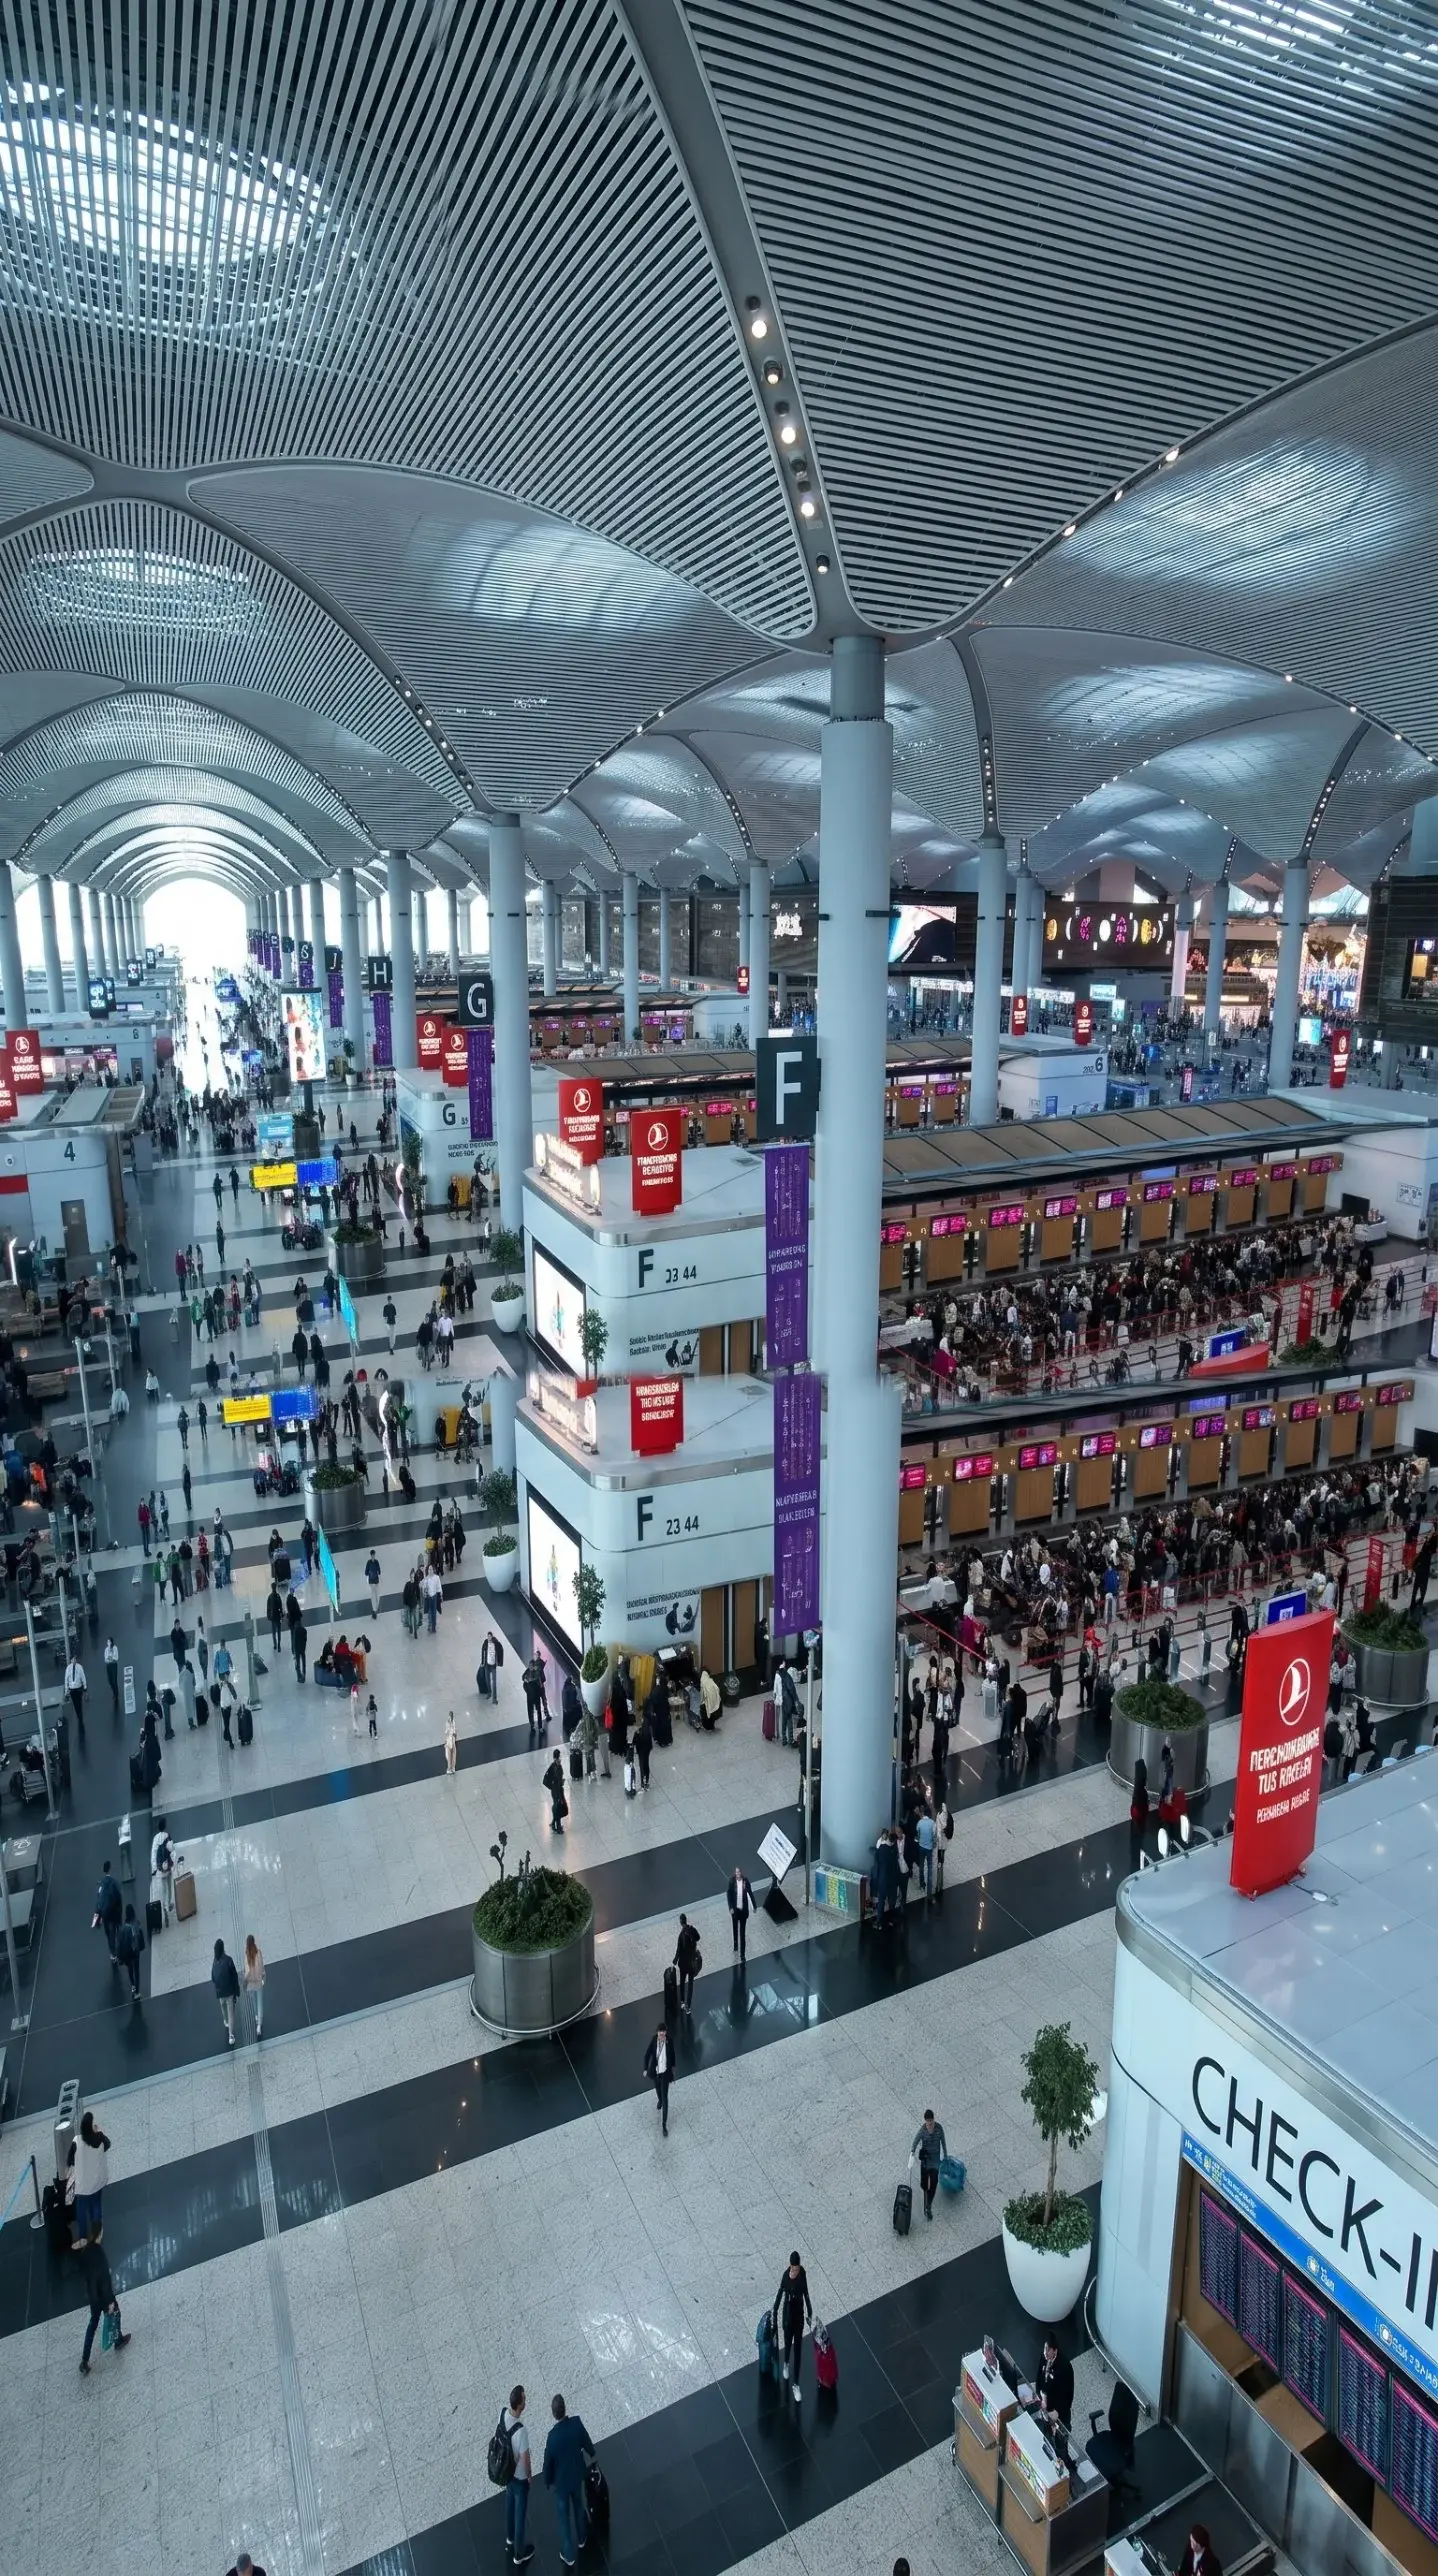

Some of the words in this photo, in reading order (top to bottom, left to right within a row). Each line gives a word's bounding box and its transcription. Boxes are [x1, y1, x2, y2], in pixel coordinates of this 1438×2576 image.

[373, 962, 388, 985] H
[467, 982, 487, 1018] G
[776, 1051, 803, 1125] F
[443, 1102, 456, 1126] G
[64, 1141, 76, 1162] 4
[638, 1248, 654, 1289] F
[682, 1264, 697, 1280] 44
[637, 1495, 653, 1541] F
[666, 1517, 681, 1536] 23
[684, 1515, 699, 1532] 44
